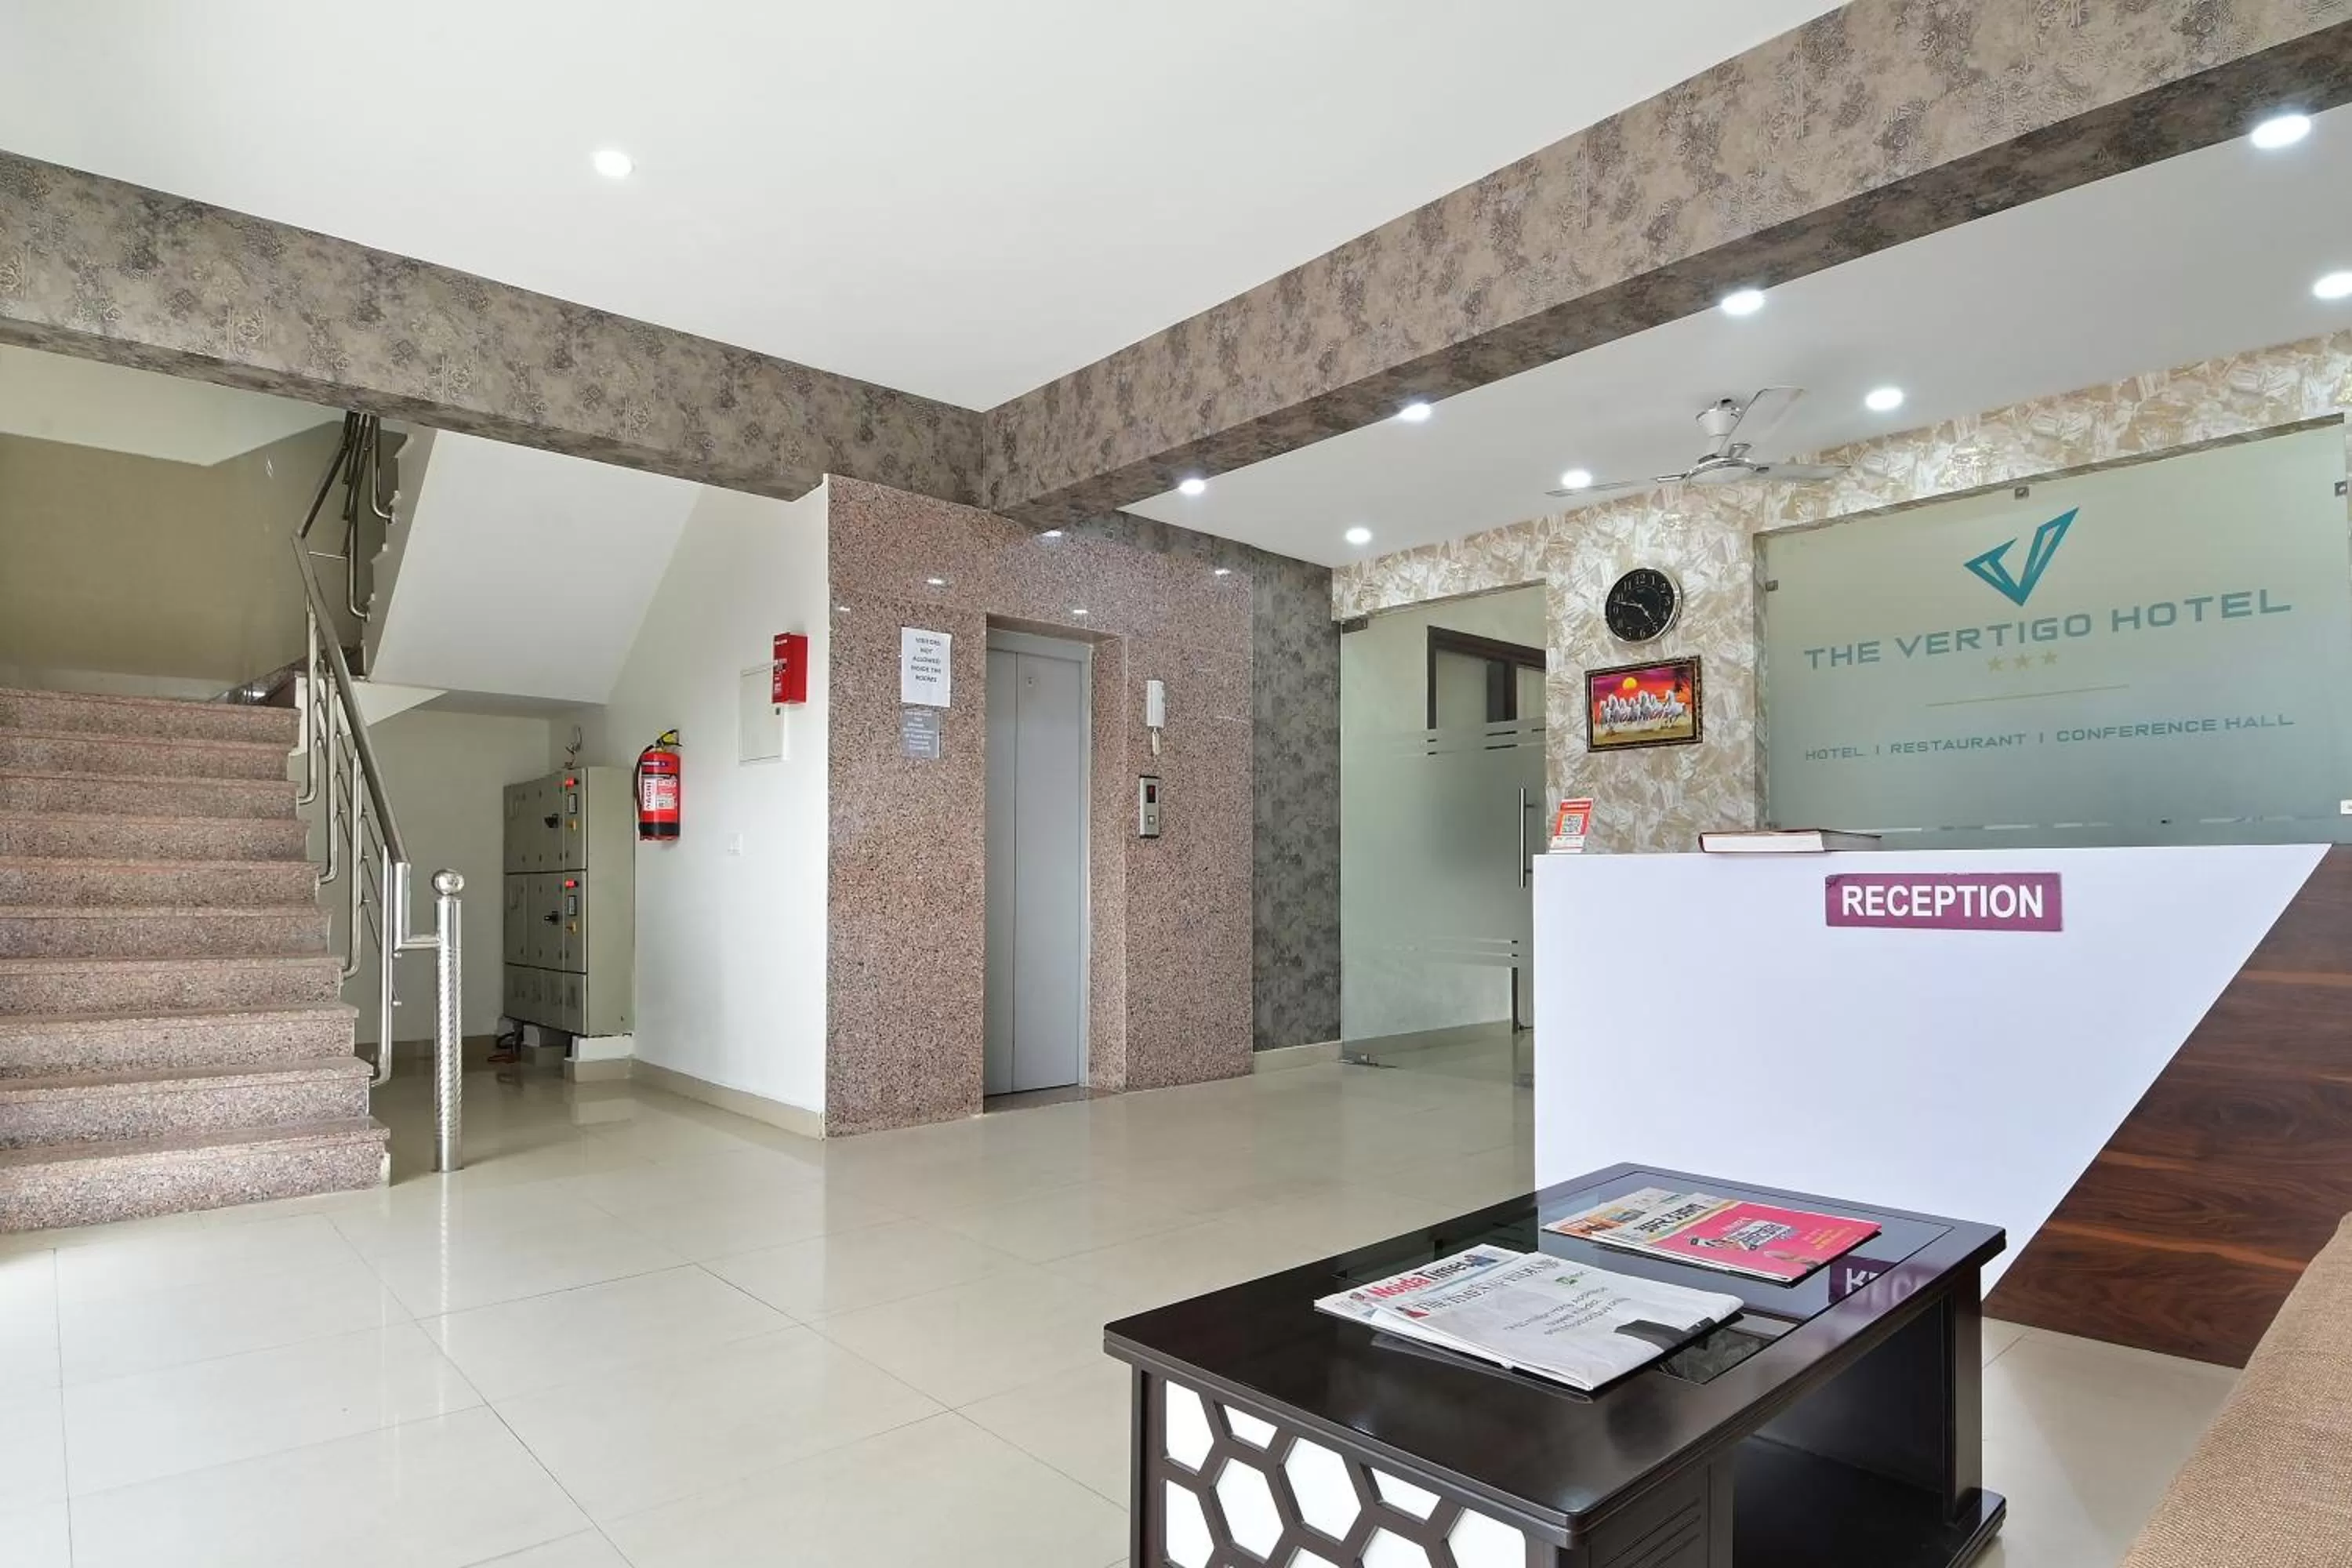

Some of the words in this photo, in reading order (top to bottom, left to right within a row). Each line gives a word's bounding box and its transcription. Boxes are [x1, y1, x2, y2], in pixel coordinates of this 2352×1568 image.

[1624, 581, 1632, 591] 11
[1635, 573, 1646, 584] 12
[1660, 583, 1666, 593] 2
[1805, 641, 1880, 670] THE
[1894, 613, 2092, 659] VERTIGO
[2111, 589, 2292, 633] HOTEL
[1806, 746, 1866, 760] HOTEL
[1890, 733, 2027, 753] RESTAURANT
[2056, 718, 2218, 742] CONFERENCE
[2224, 714, 2296, 730] HALL
[1842, 884, 2044, 918] RECEPTION
